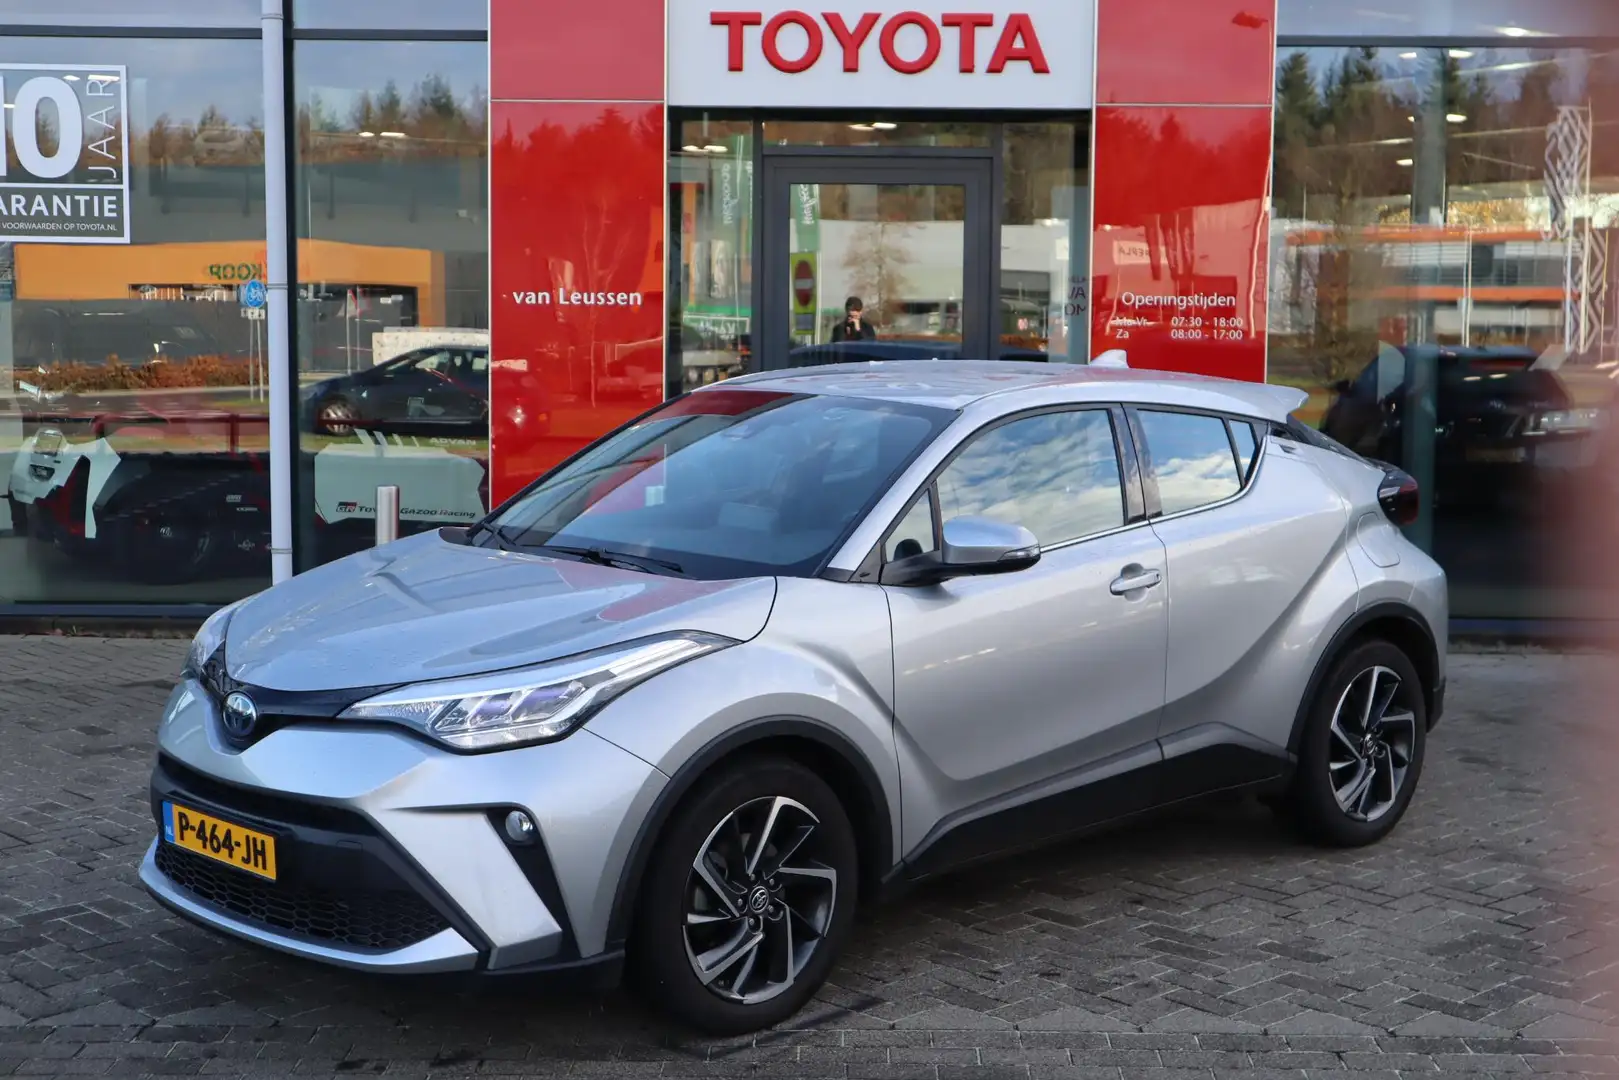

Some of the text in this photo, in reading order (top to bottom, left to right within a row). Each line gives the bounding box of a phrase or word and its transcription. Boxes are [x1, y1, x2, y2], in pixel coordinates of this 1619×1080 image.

[710, 10, 1050, 74] TOYOTA
[0, 76, 82, 178] 0
[86, 78, 117, 179] JAAR
[2, 222, 118, 231] VOORWAARDEN OP TOYOTA.NL
[512, 287, 642, 305] van Leussen
[1121, 291, 1236, 309] Openingstijden
[1171, 317, 1202, 327] 07:30
[1213, 317, 1243, 327] 18:00
[1115, 329, 1129, 339] Za
[1171, 329, 1201, 339] 08:00
[1213, 329, 1243, 339] 17:00
[438, 508, 476, 518] Racing
[178, 811, 267, 871] P-464-JH
